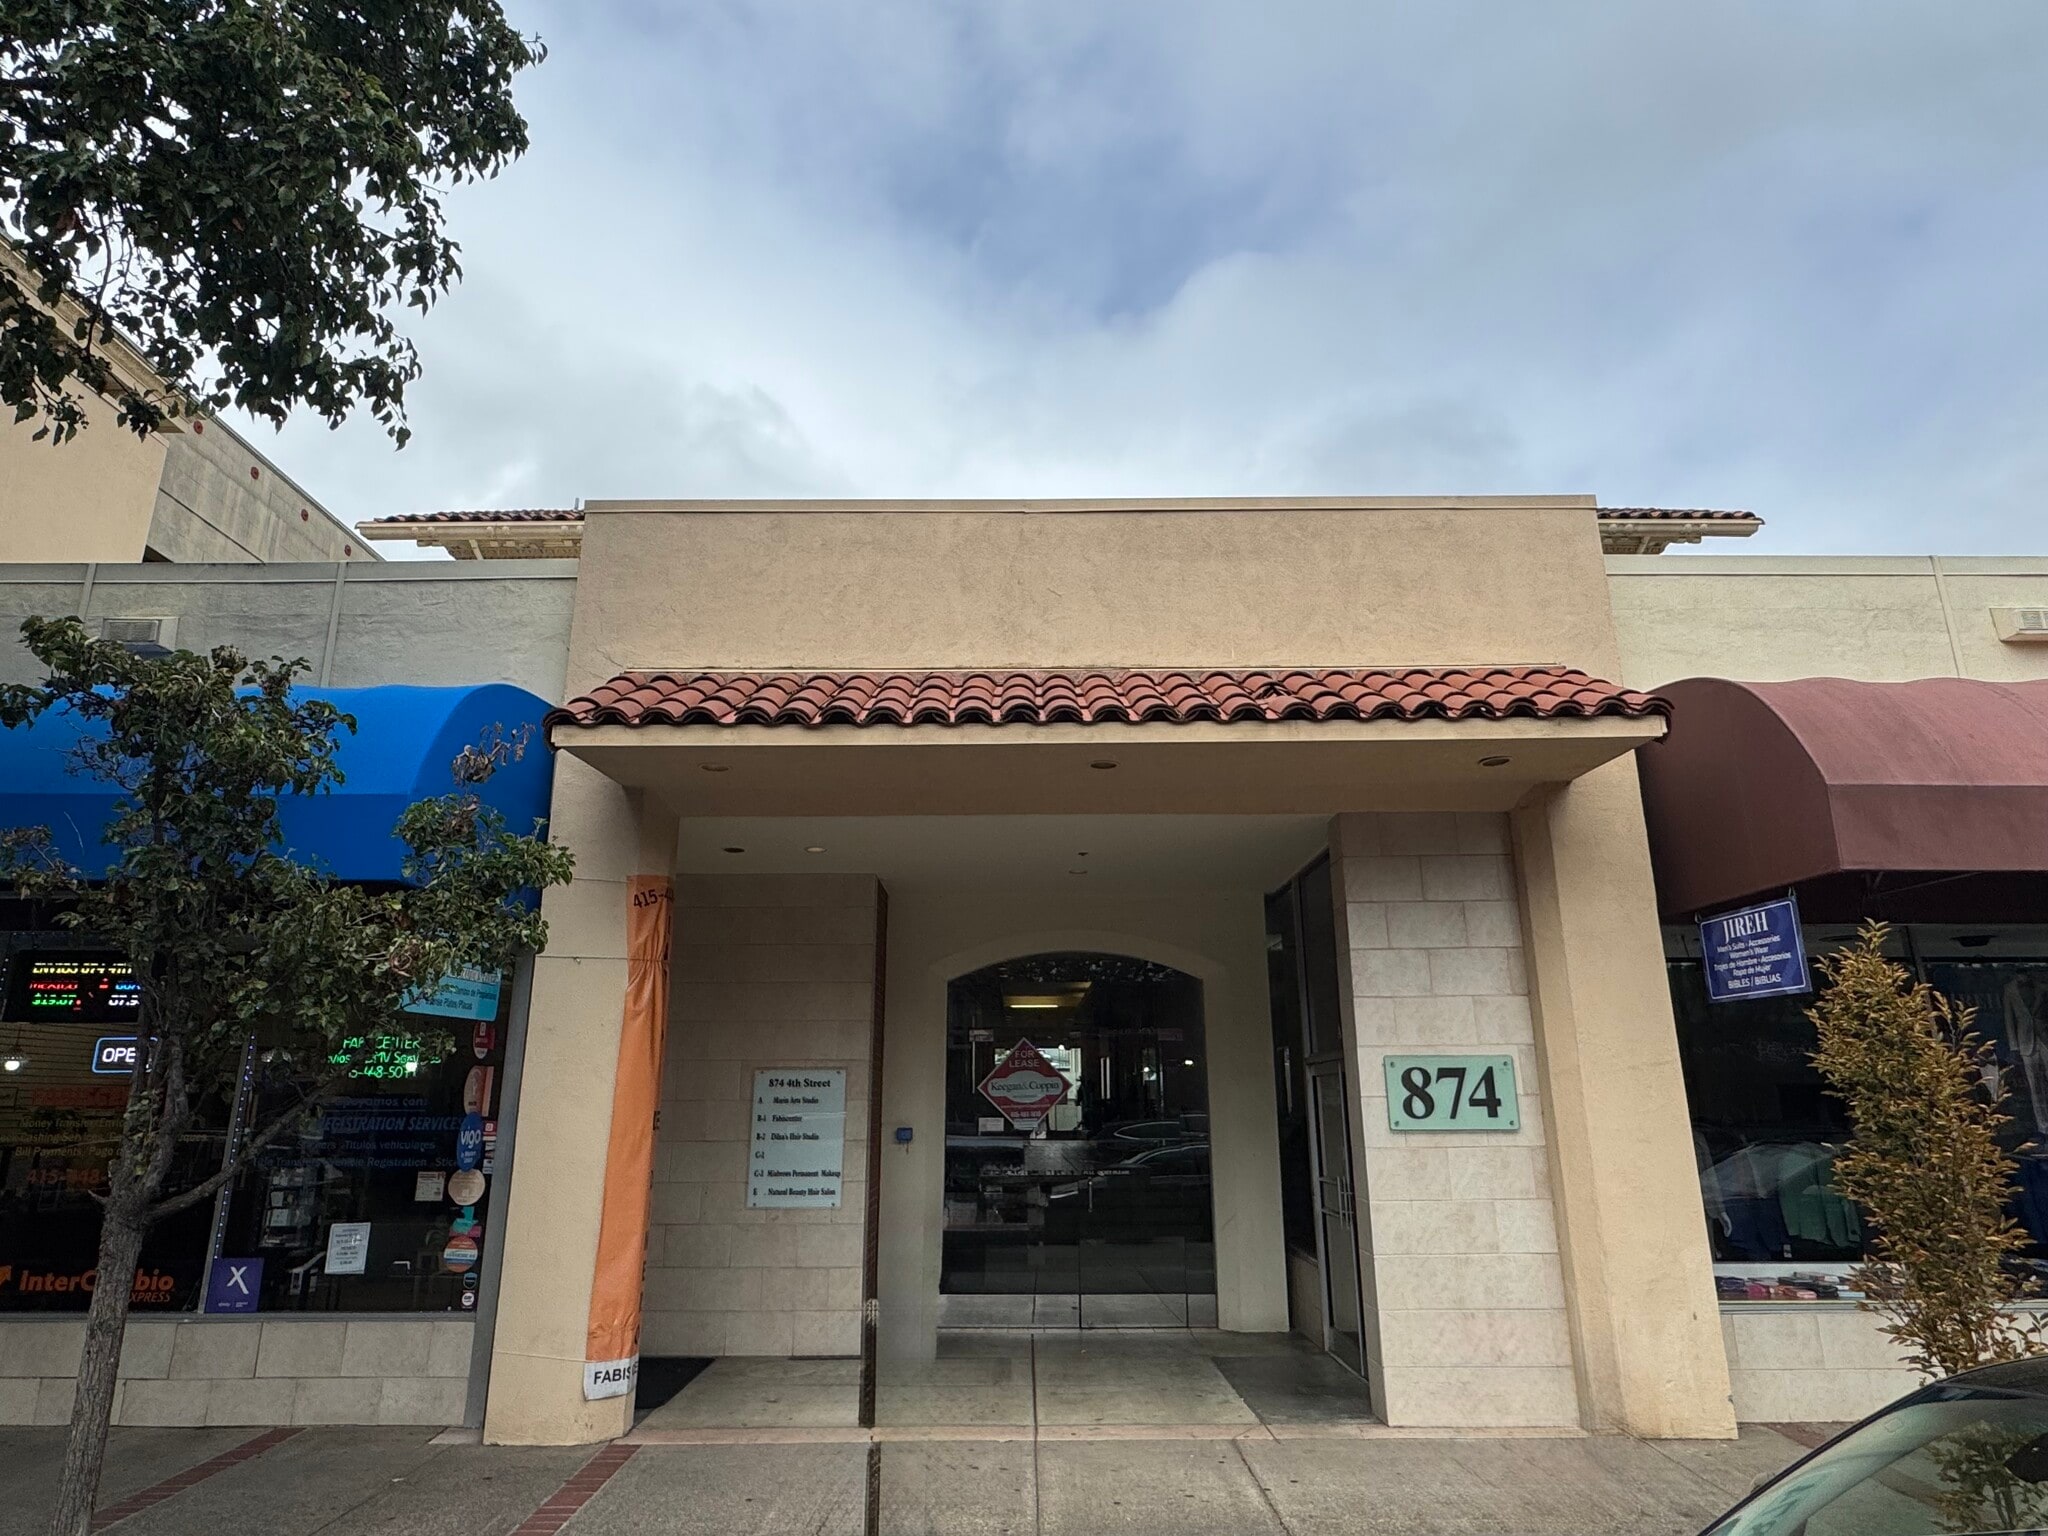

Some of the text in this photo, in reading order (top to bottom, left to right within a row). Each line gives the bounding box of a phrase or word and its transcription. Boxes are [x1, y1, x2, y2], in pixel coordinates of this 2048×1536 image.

[1723, 911, 1768, 944] JIREH
[1729, 946, 1769, 959] Women's Wear
[1727, 978, 1750, 990] BIBLES
[1754, 973, 1781, 986] BIBLIAS
[102, 1047, 137, 1062] OPE
[1014, 1050, 1034, 1058] FOR
[1008, 1059, 1040, 1068] LEASE
[769, 1078, 831, 1088] 874 4th Street
[1029, 1081, 1059, 1093] Coppin
[1401, 1066, 1502, 1119] 874
[757, 1096, 763, 1104] A
[460, 1126, 482, 1150] vigo
[15, 1146, 31, 1157] Bill
[18, 1265, 175, 1293] InterCbio
[130, 1290, 171, 1304] XPRESS
